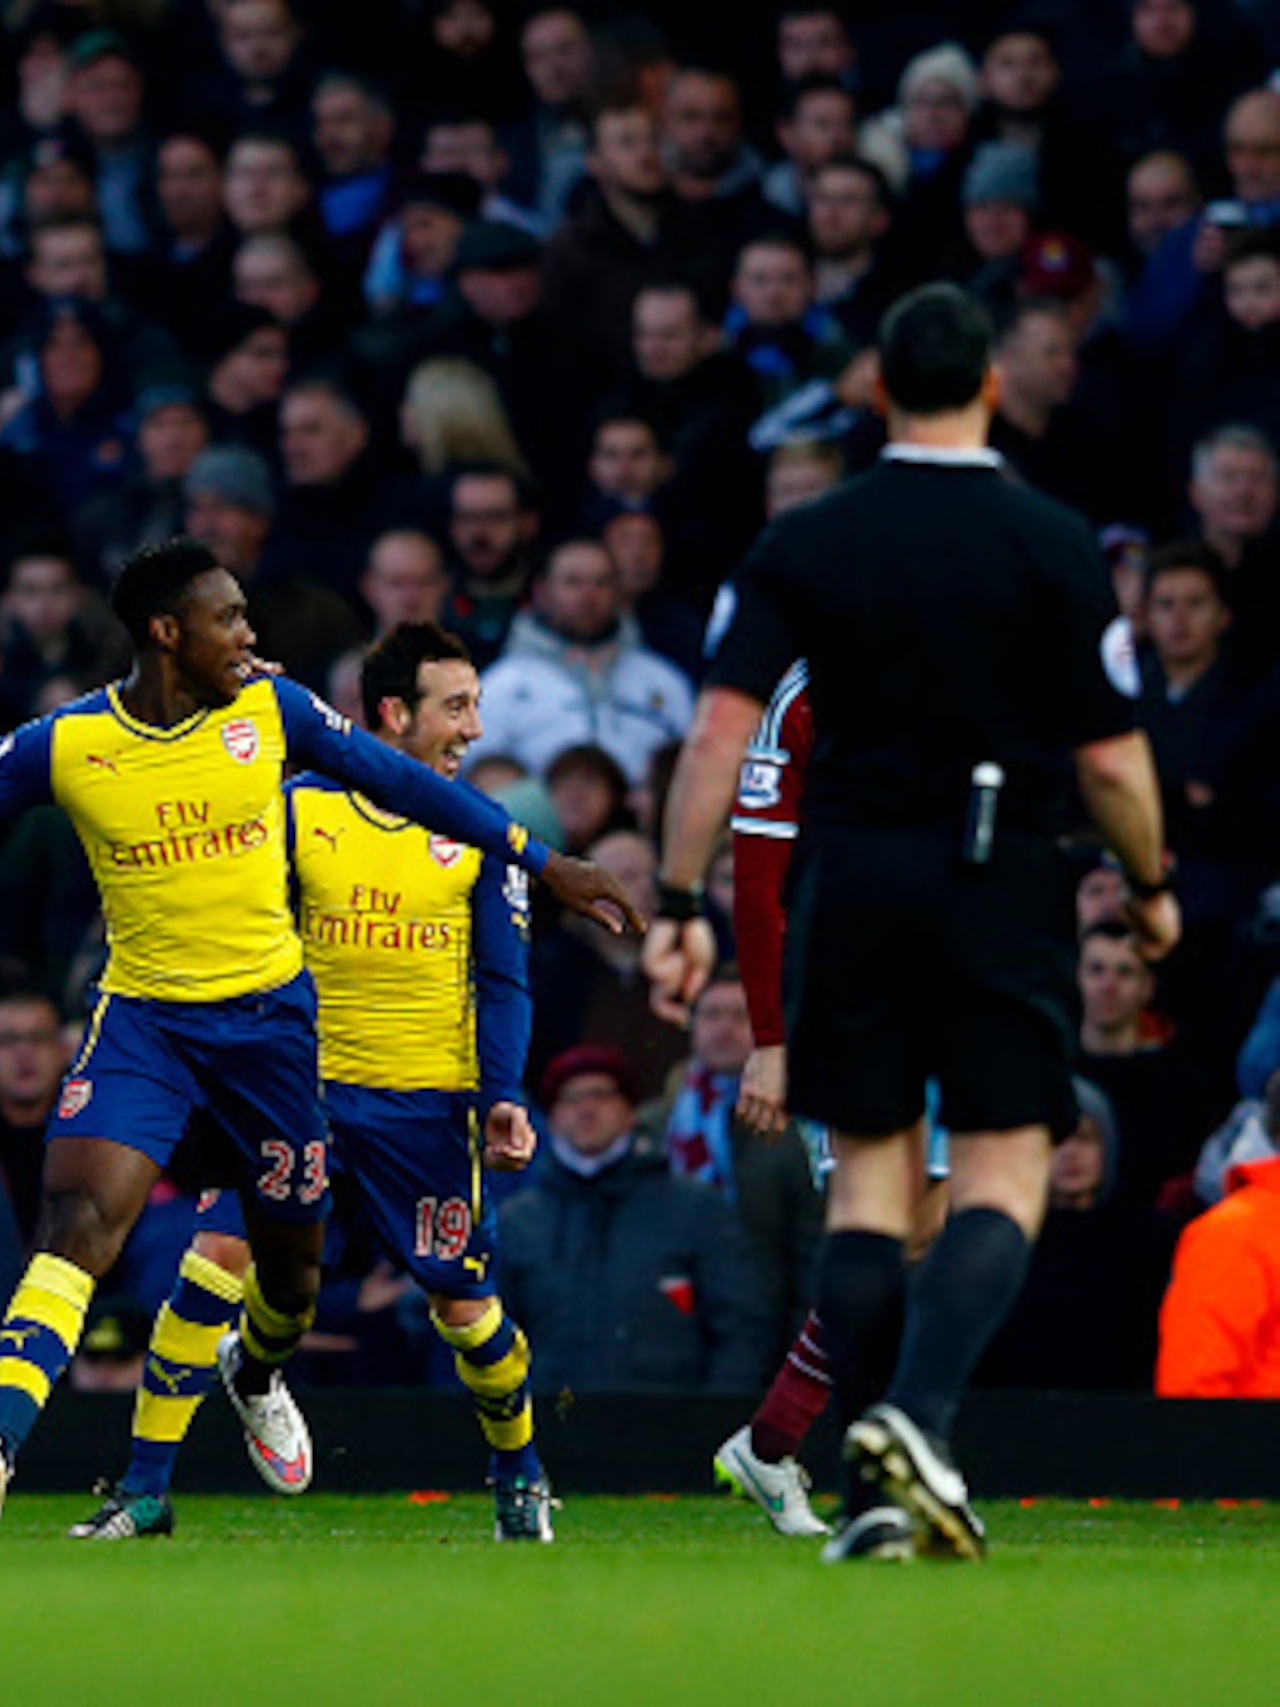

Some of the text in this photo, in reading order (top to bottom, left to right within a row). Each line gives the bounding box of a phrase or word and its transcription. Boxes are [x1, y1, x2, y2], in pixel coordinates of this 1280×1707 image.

[156, 800, 210, 828] Fly
[111, 816, 268, 869] Emirates
[351, 884, 401, 916] Fly
[306, 905, 451, 951] Emirates
[257, 1139, 326, 1203] 23
[415, 1196, 472, 1260] 19
